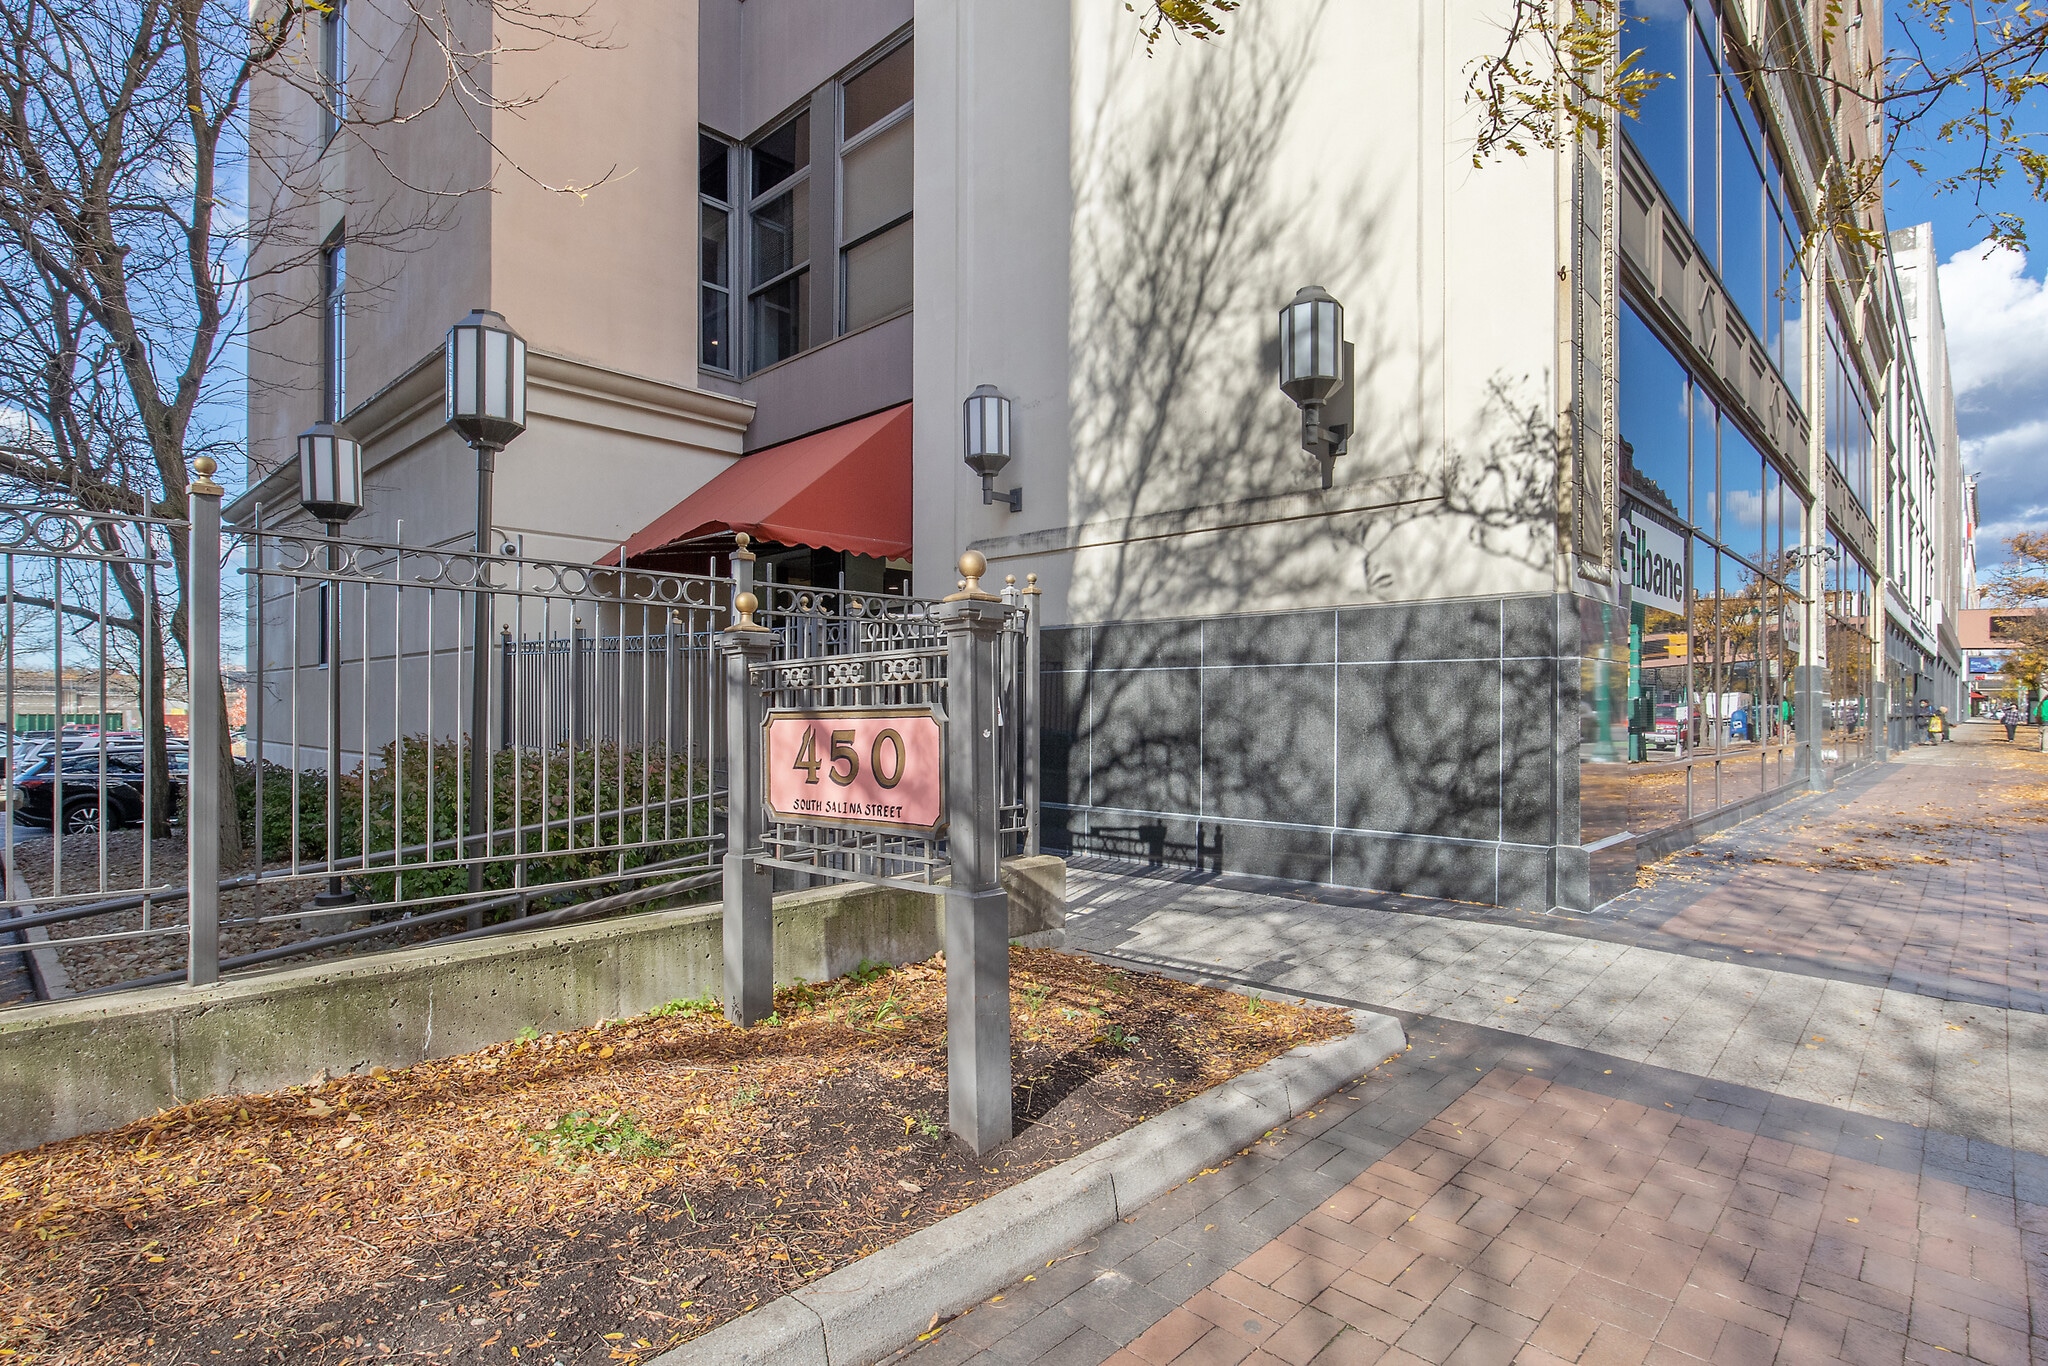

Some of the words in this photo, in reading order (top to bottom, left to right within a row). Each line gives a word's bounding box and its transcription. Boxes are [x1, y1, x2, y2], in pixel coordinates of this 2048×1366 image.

[1619, 525, 1683, 602] Gilbane
[793, 724, 906, 790] 450
[793, 798, 823, 812] SOUTH
[825, 800, 862, 815] SALINA
[864, 804, 903, 819] STREET
